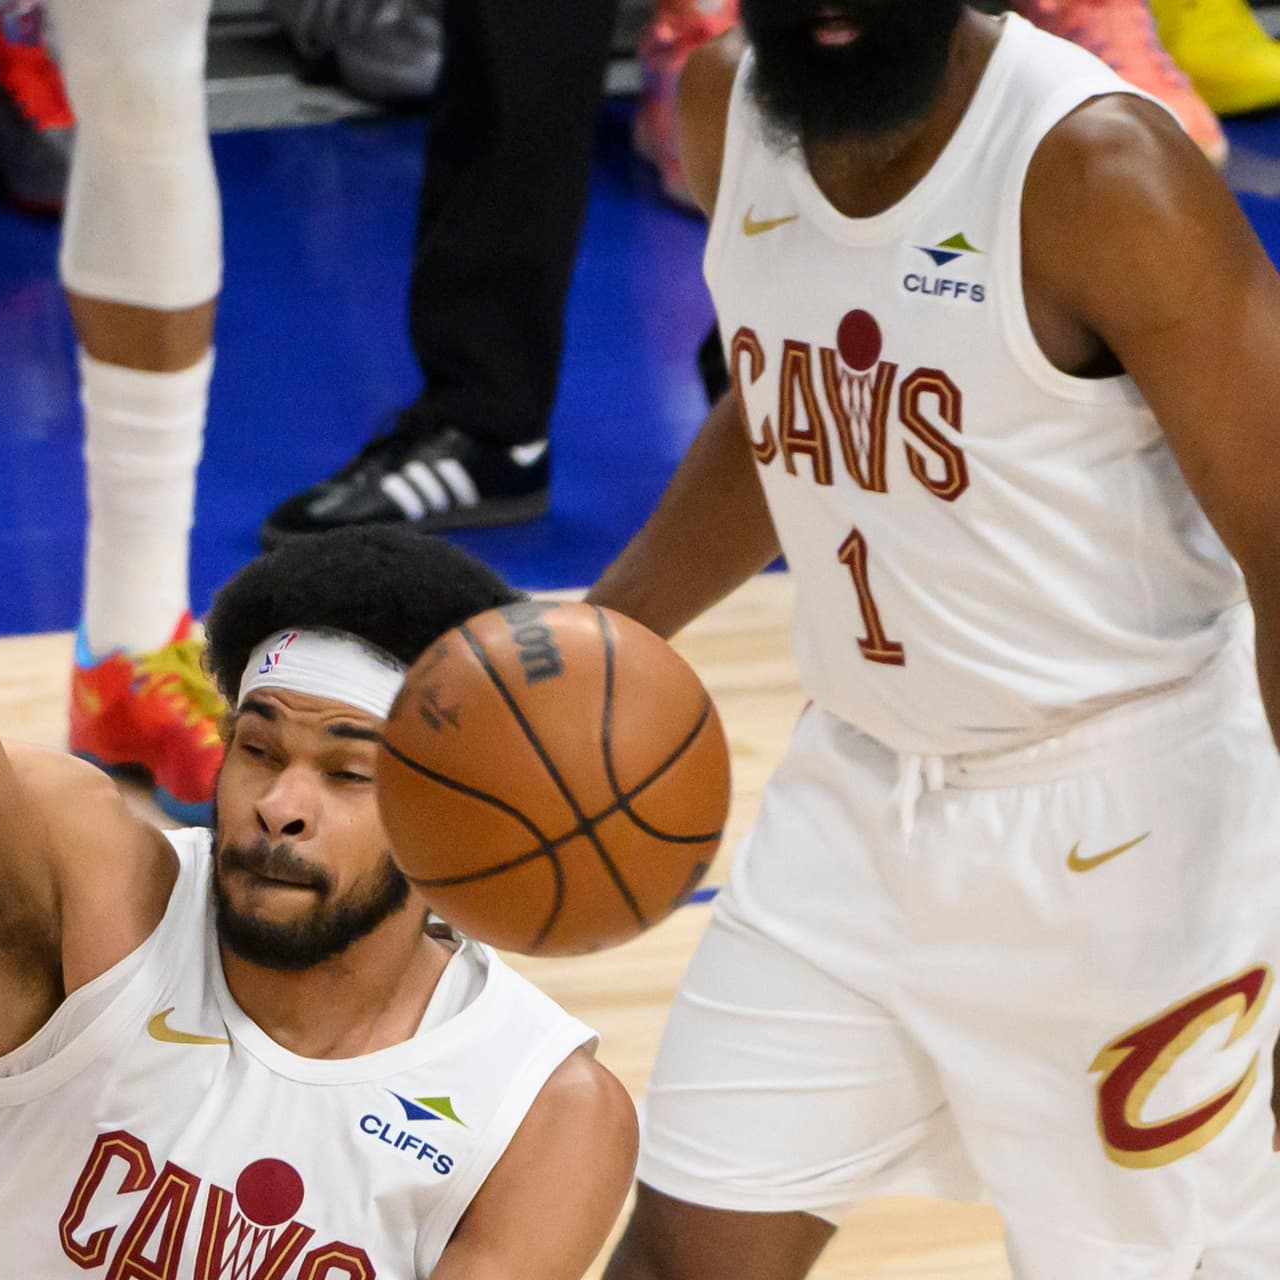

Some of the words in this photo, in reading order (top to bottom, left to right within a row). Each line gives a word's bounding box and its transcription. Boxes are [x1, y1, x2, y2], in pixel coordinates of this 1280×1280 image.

[903, 273, 985, 303] CLIFFS
[731, 325, 970, 502] CAVS
[838, 528, 906, 666] 1
[359, 1114, 454, 1175] CLIFFS
